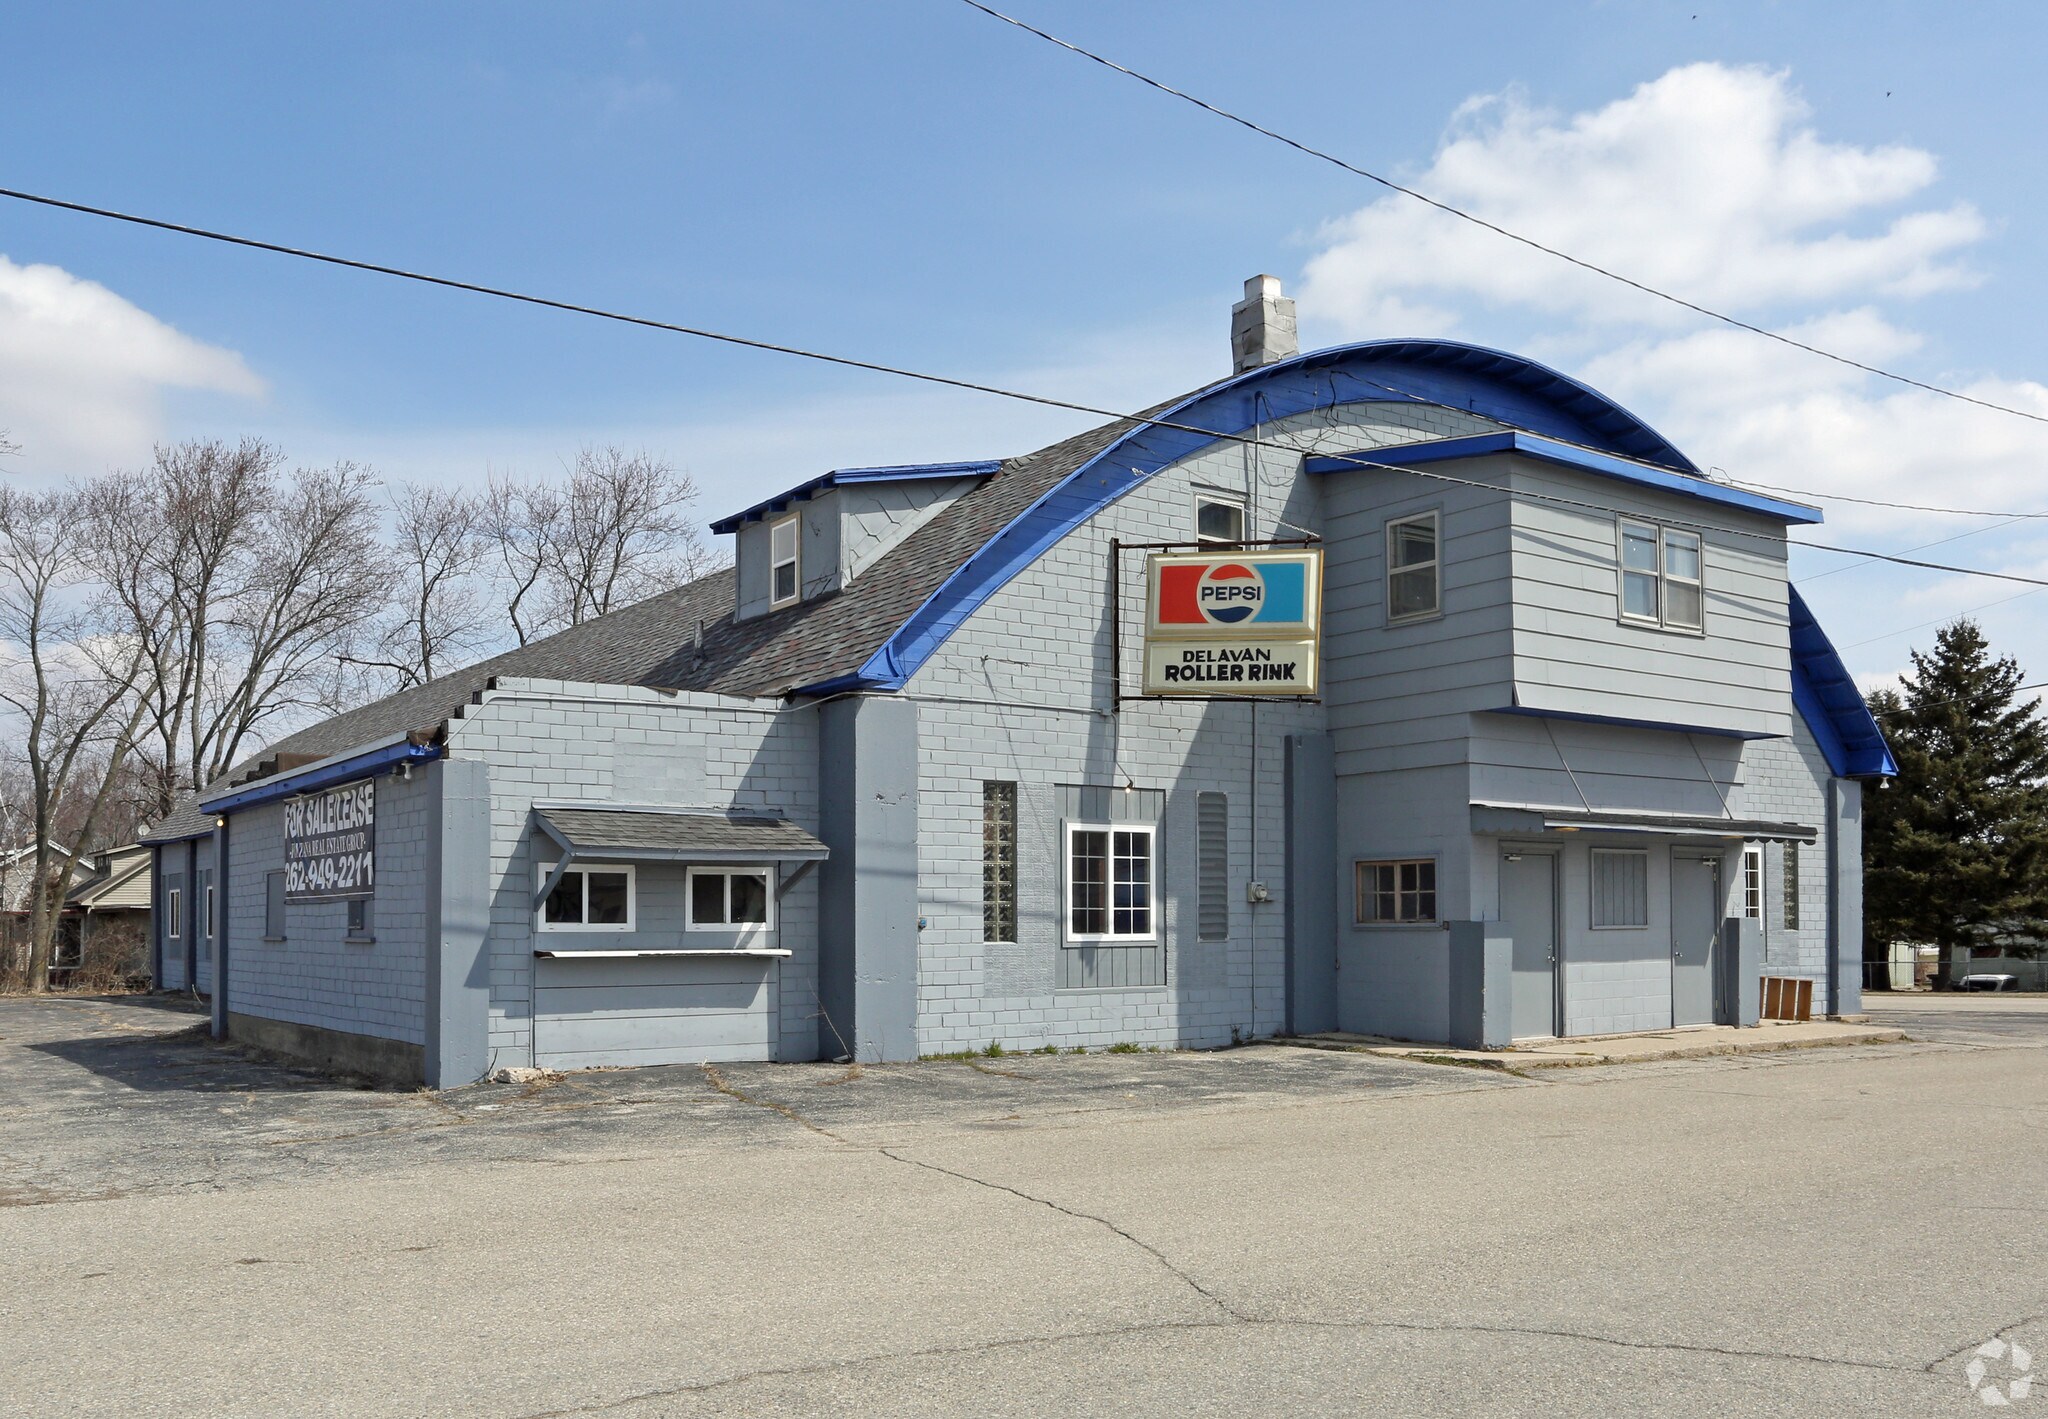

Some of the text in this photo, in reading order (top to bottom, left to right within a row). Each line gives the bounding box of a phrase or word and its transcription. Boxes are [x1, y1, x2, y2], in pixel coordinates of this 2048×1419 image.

[1201, 585, 1261, 601] PEPSI
[1182, 647, 1271, 663] DELAVAN
[1165, 661, 1296, 683] ROLLER RINK
[285, 798, 305, 839] FOR
[312, 839, 326, 856] REAL
[326, 835, 347, 855] ESTATE
[285, 851, 374, 892] 262-949-2211
